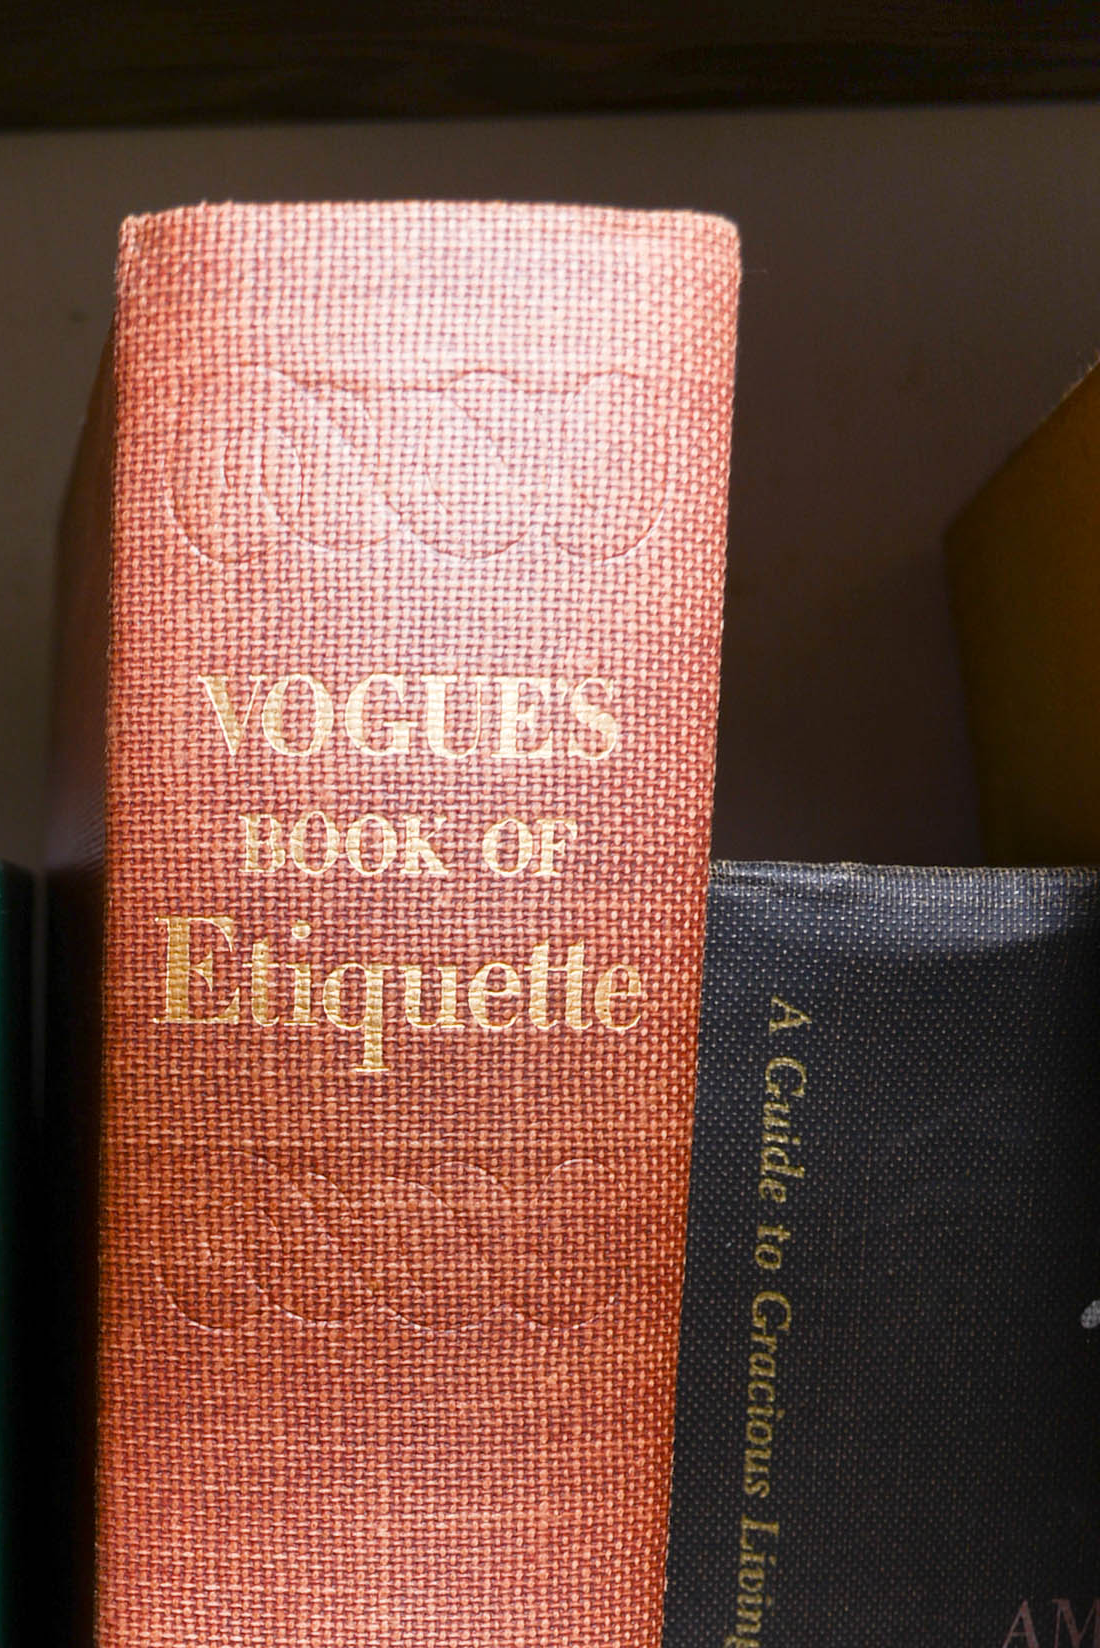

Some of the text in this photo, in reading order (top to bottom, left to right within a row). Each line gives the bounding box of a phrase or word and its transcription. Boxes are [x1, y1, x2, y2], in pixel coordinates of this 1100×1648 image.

[198, 672, 620, 760] VOGUE'S
[238, 810, 579, 878] BOOK OF
[152, 915, 645, 1073] Etiquette
[768, 996, 811, 1034] A
[757, 1056, 808, 1204] Guide
[754, 1222, 793, 1272] to
[743, 1291, 793, 1500] Gracious
